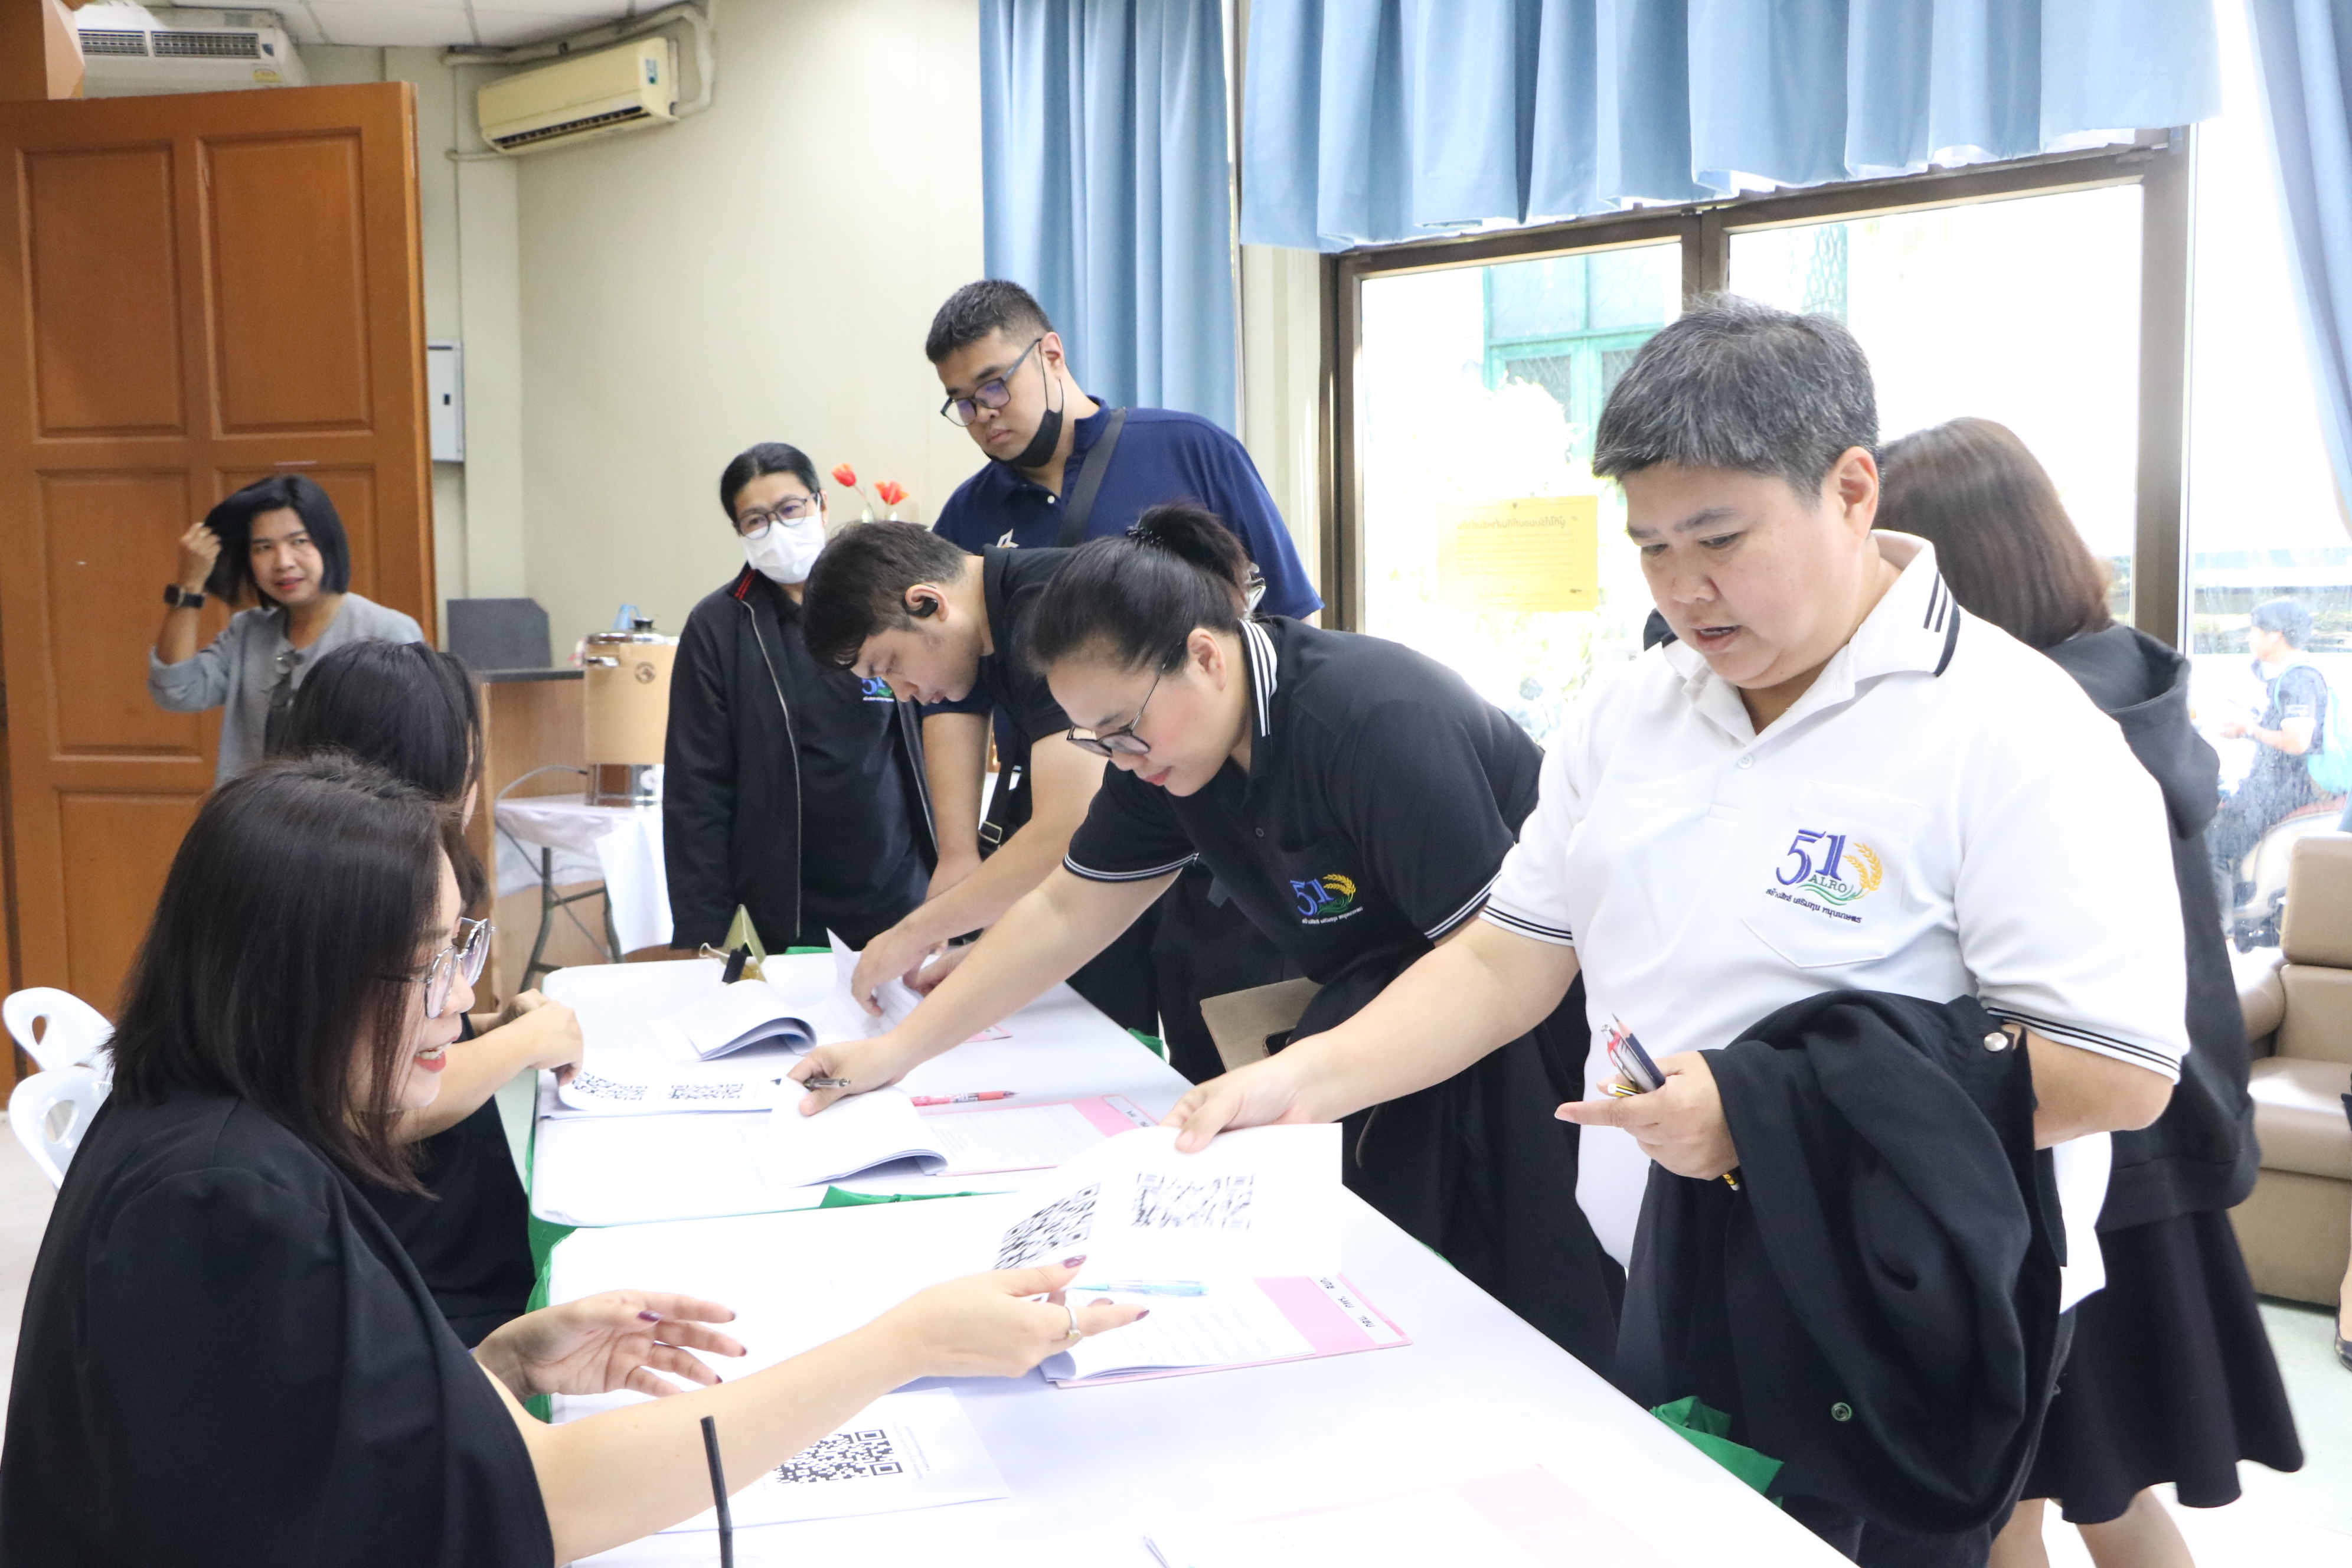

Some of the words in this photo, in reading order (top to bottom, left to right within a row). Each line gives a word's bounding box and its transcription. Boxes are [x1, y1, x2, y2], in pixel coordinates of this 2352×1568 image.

[1776, 829, 1846, 885] 51
[1290, 878, 1334, 916] 51
[1808, 874, 1847, 893] ALRO
